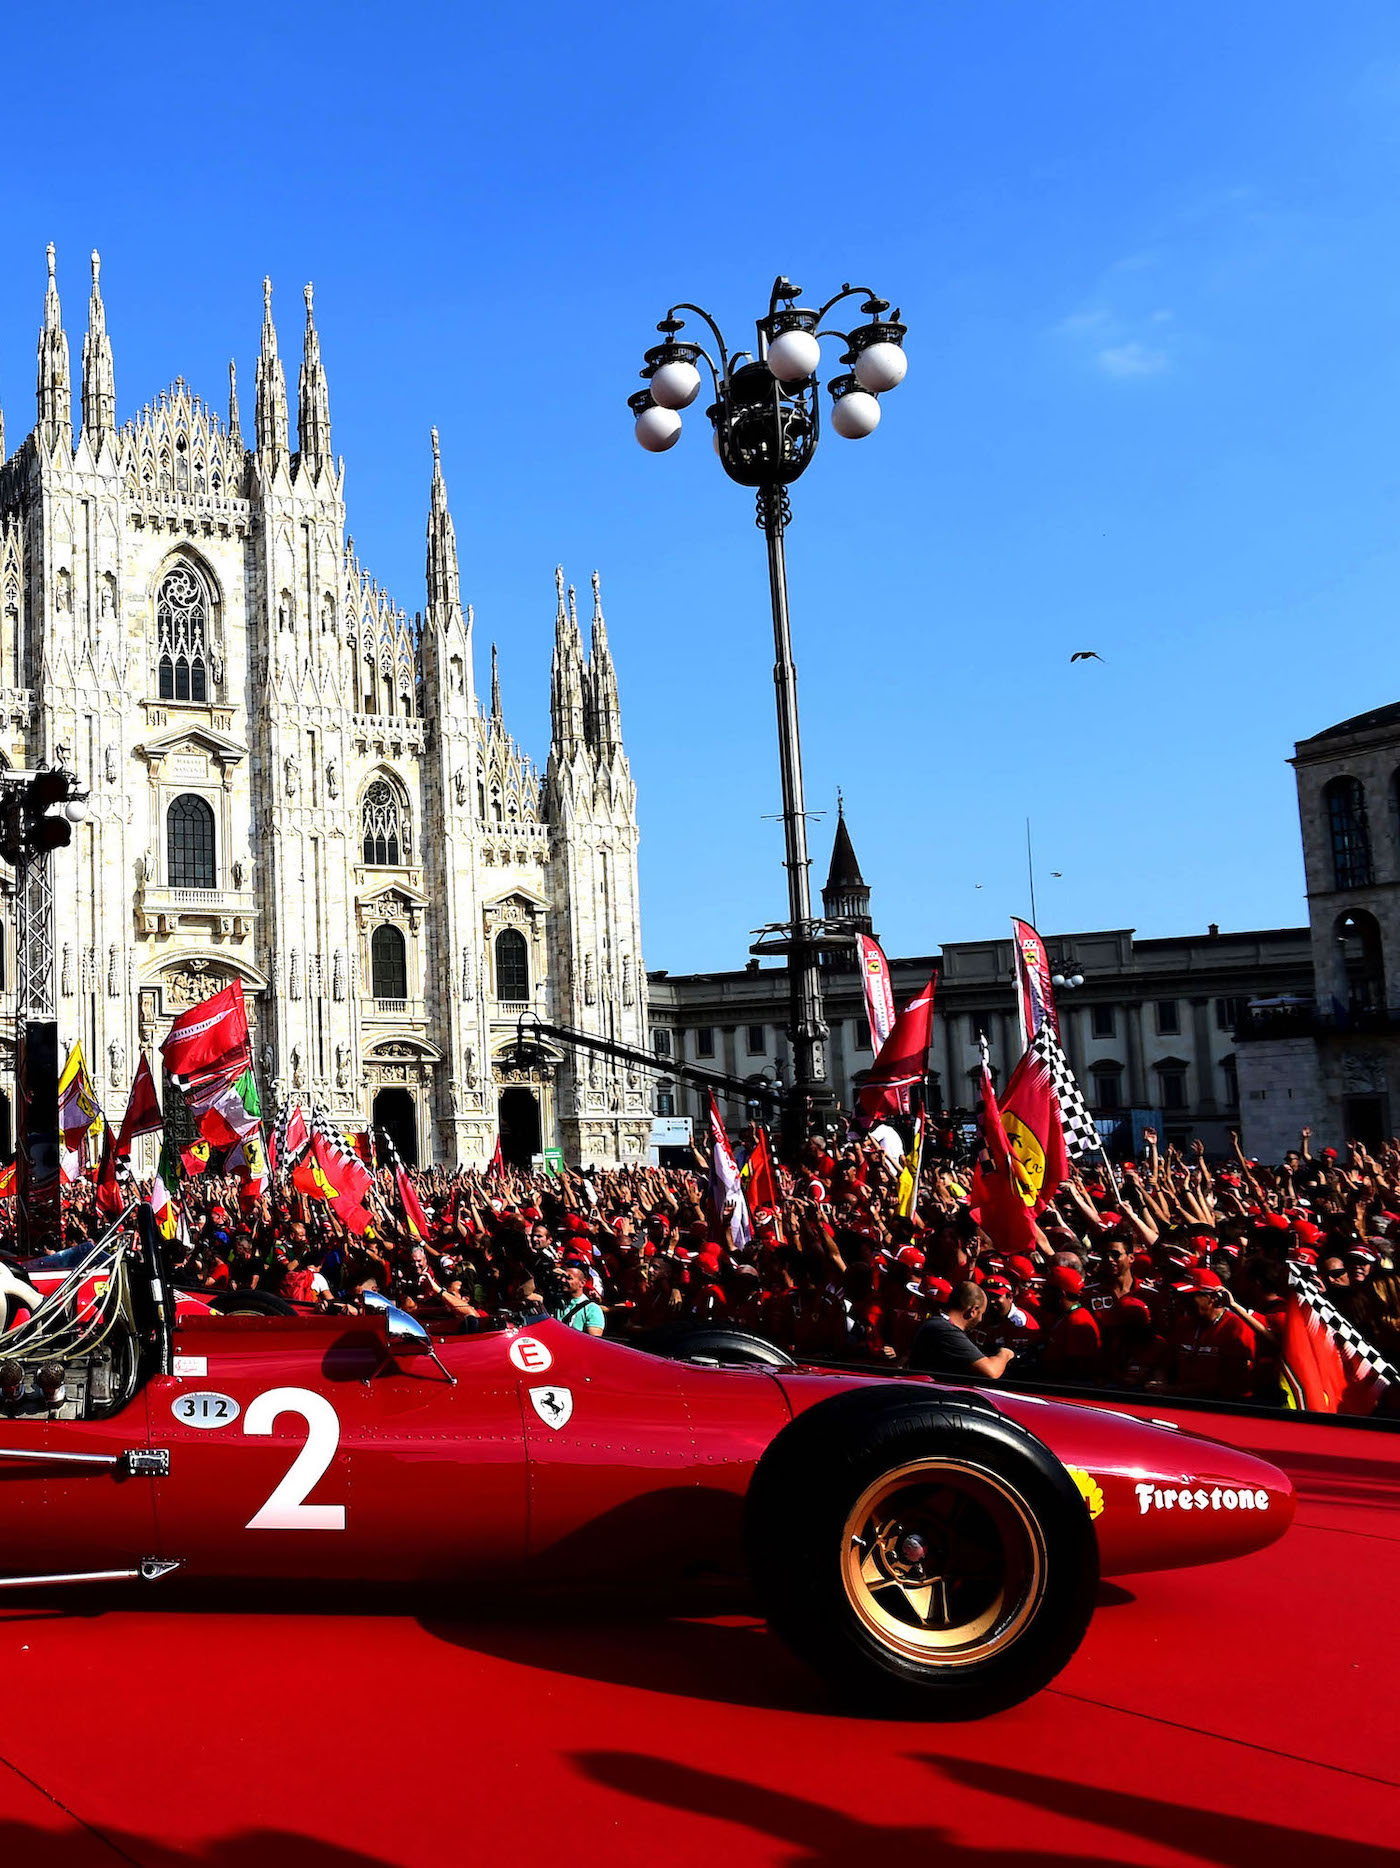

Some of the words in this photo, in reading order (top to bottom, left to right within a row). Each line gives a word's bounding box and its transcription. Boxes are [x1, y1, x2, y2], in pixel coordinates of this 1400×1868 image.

[518, 1343, 544, 1367] E
[183, 1399, 228, 1418] 312
[243, 1387, 346, 1530] 2
[1135, 1483, 1270, 1515] Firestone
